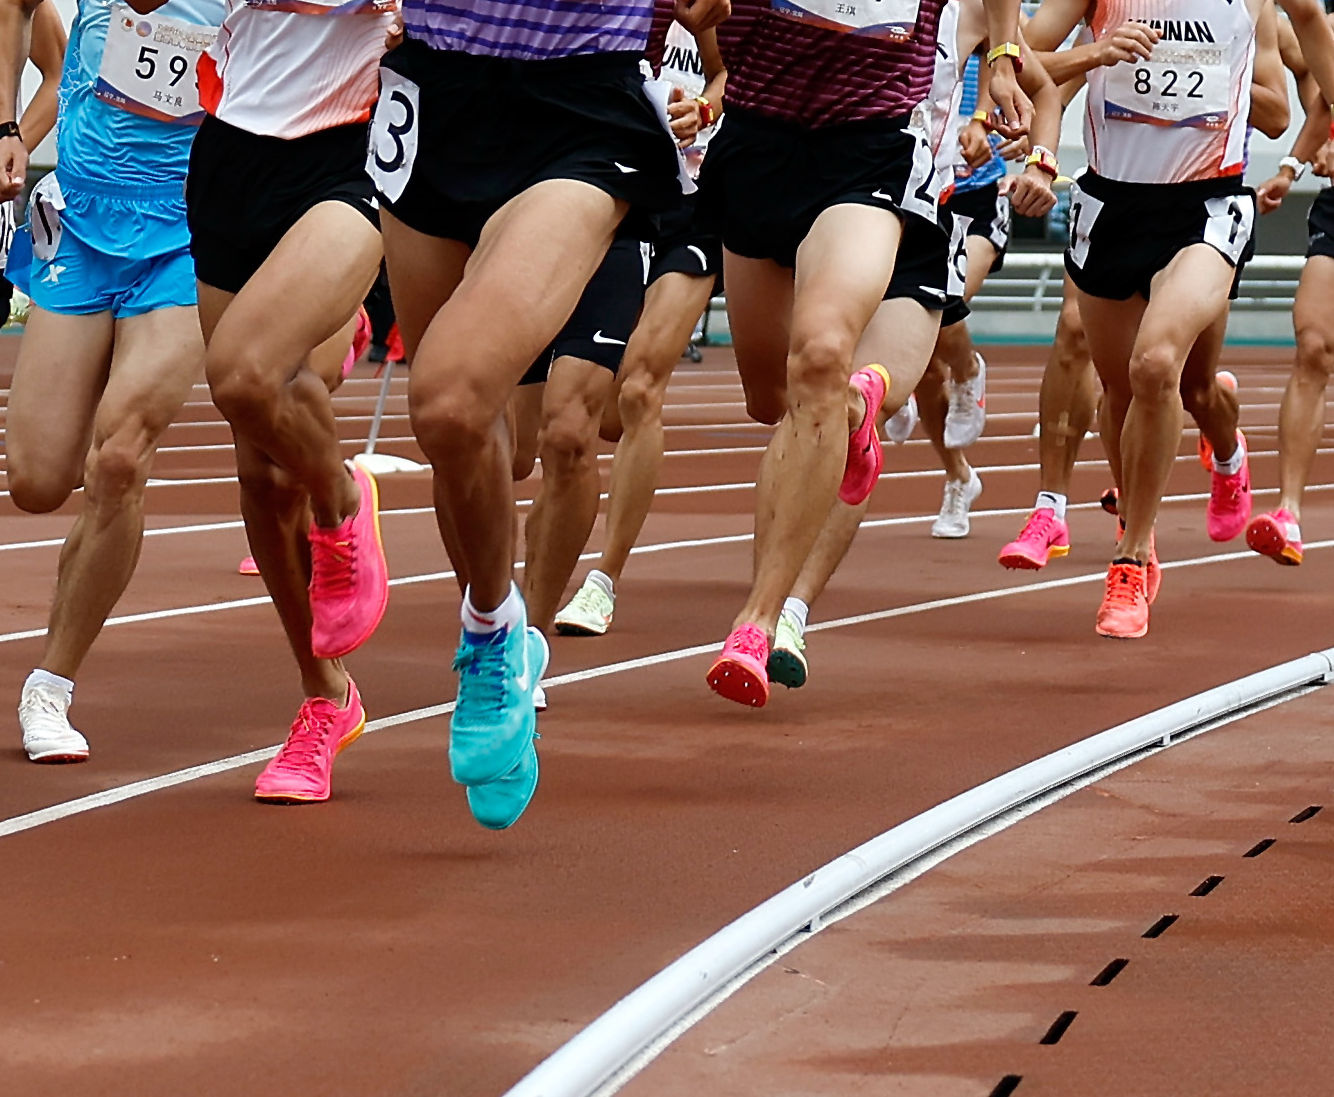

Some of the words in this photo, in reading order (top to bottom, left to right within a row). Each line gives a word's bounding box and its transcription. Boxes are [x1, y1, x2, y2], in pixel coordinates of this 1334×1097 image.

[135, 46, 198, 89] 59
[1134, 68, 1204, 98] 822
[375, 90, 414, 173] 3
